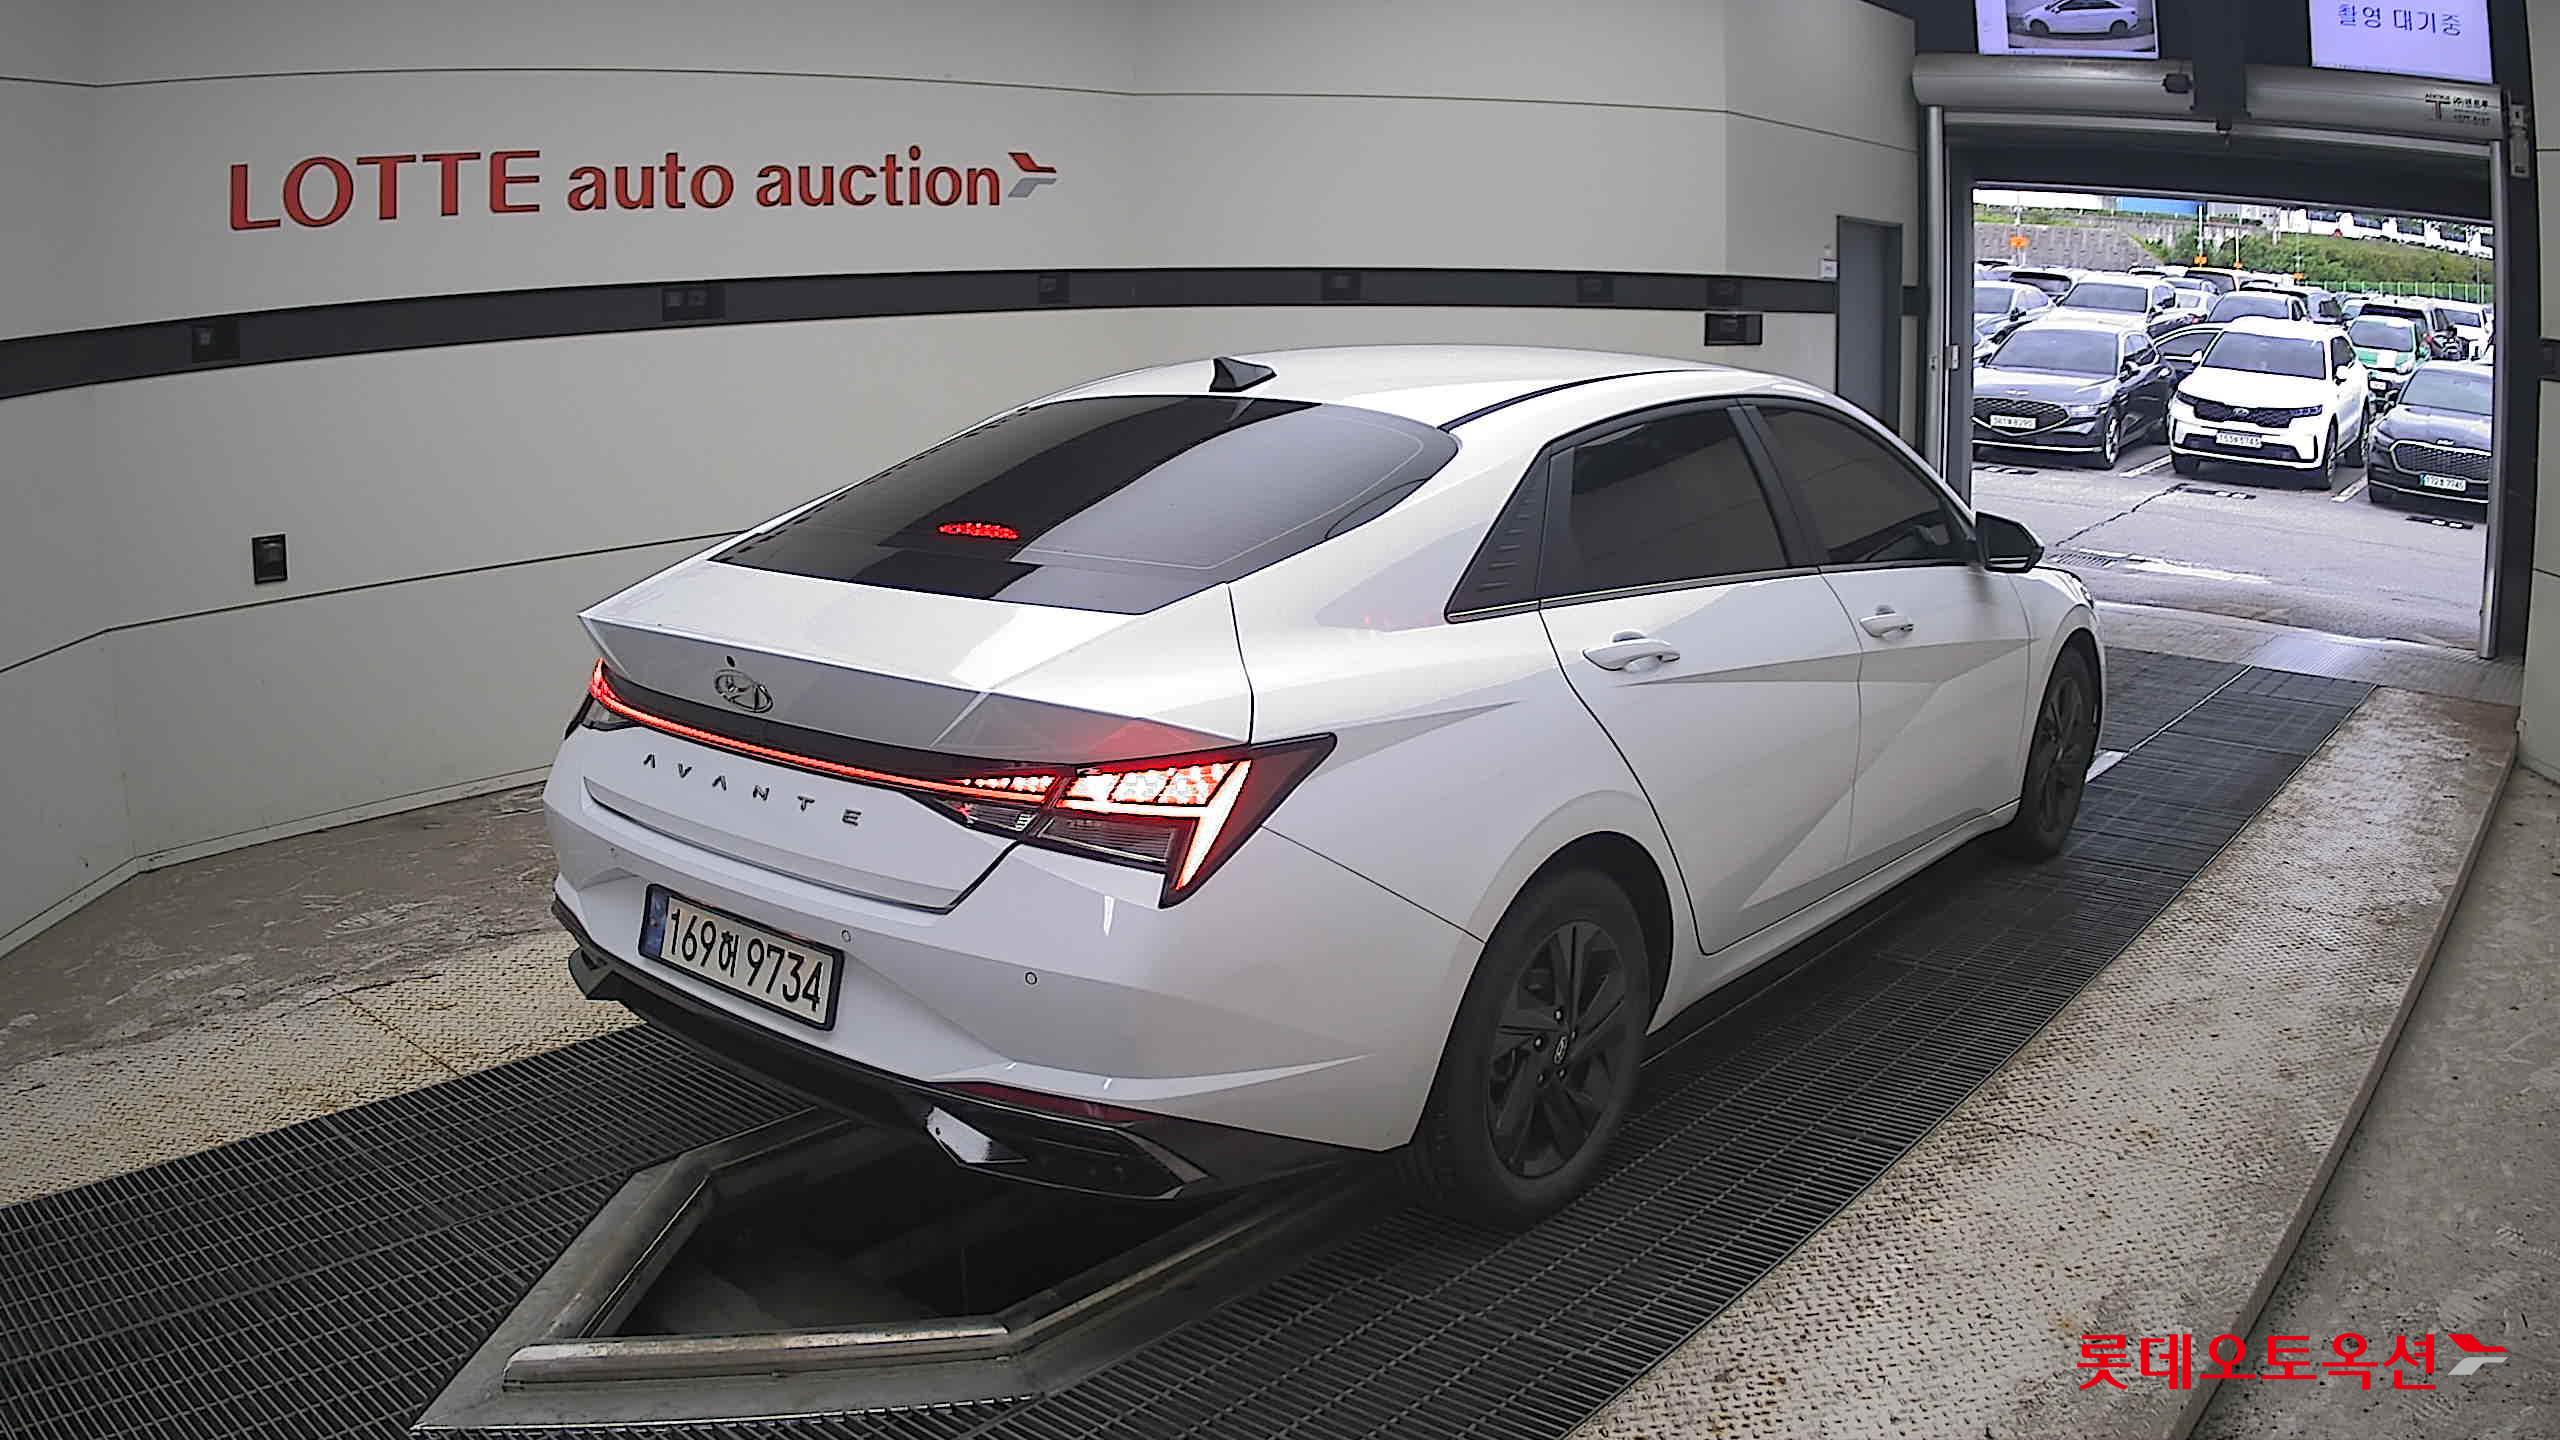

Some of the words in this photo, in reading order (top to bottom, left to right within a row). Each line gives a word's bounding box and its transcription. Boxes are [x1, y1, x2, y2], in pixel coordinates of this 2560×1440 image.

[2338, 3, 2382, 29] 촬영
[2393, 9, 2462, 37] 대기중
[229, 149, 541, 231] LOTTE
[568, 151, 735, 211] auto
[755, 145, 1002, 208] auction
[642, 752, 862, 827] AVANTE
[747, 937, 823, 1012] 9734
